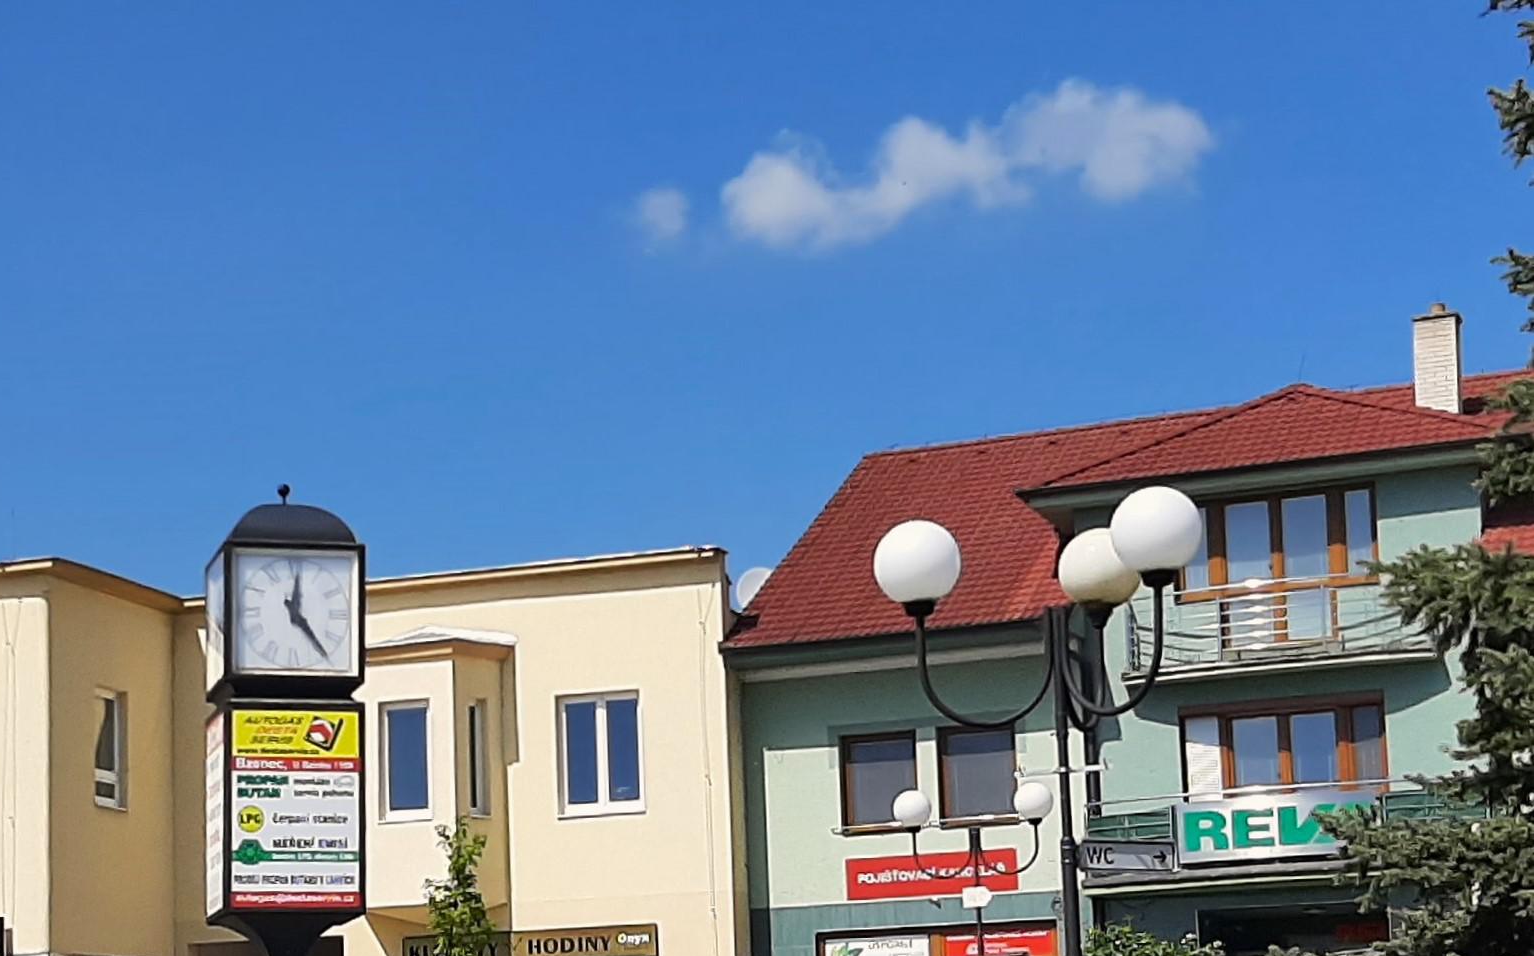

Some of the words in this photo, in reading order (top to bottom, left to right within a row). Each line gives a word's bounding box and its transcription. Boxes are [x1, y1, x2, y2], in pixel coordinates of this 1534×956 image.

[236, 775, 289, 785] PROPAN
[236, 787, 282, 798] BUTAN
[240, 813, 261, 824] LPG
[1087, 847, 1115, 865] WC
[528, 932, 611, 955] HODINY
[617, 932, 650, 946] Onyx
